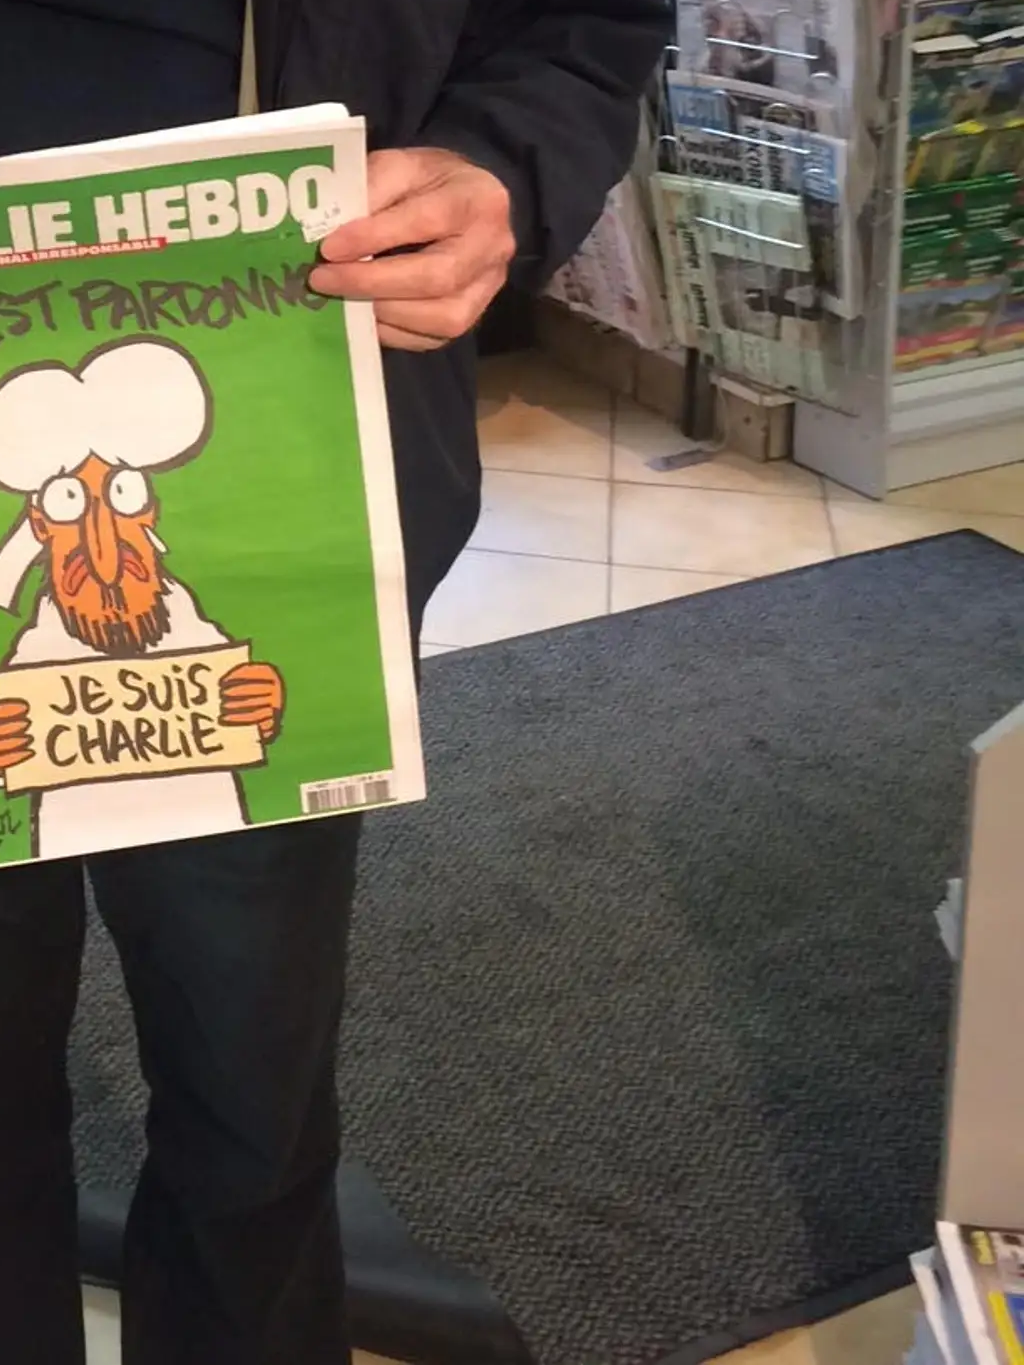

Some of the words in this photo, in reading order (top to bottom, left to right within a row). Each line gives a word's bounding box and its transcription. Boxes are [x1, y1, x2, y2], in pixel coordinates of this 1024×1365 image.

[95, 164, 334, 246] HEBDO
[30, 237, 161, 262] IRRESPONSABLE
[49, 675, 113, 716] JE
[46, 713, 224, 766] CHARLIE
